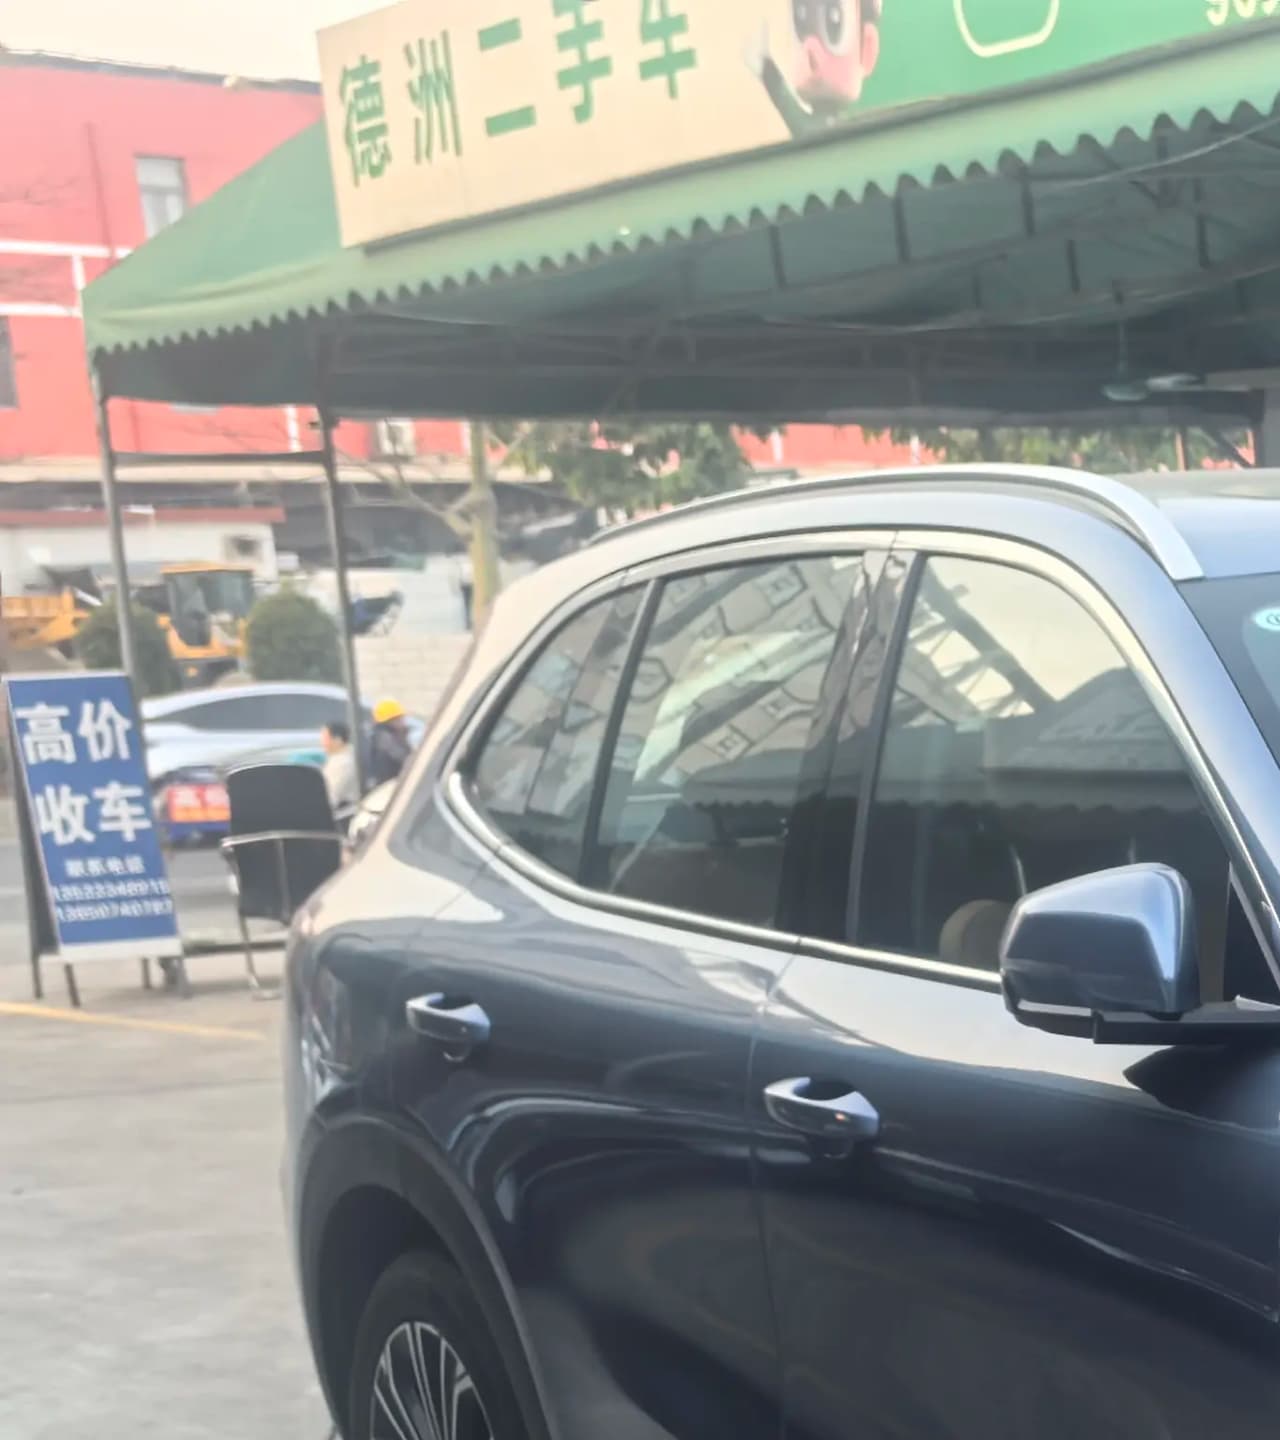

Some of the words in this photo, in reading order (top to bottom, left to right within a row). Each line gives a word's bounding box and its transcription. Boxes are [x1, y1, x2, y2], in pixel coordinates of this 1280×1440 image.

[338, 0, 698, 189] 德洲二手车
[15, 699, 132, 765] 高价
[35, 781, 152, 846] 收车
